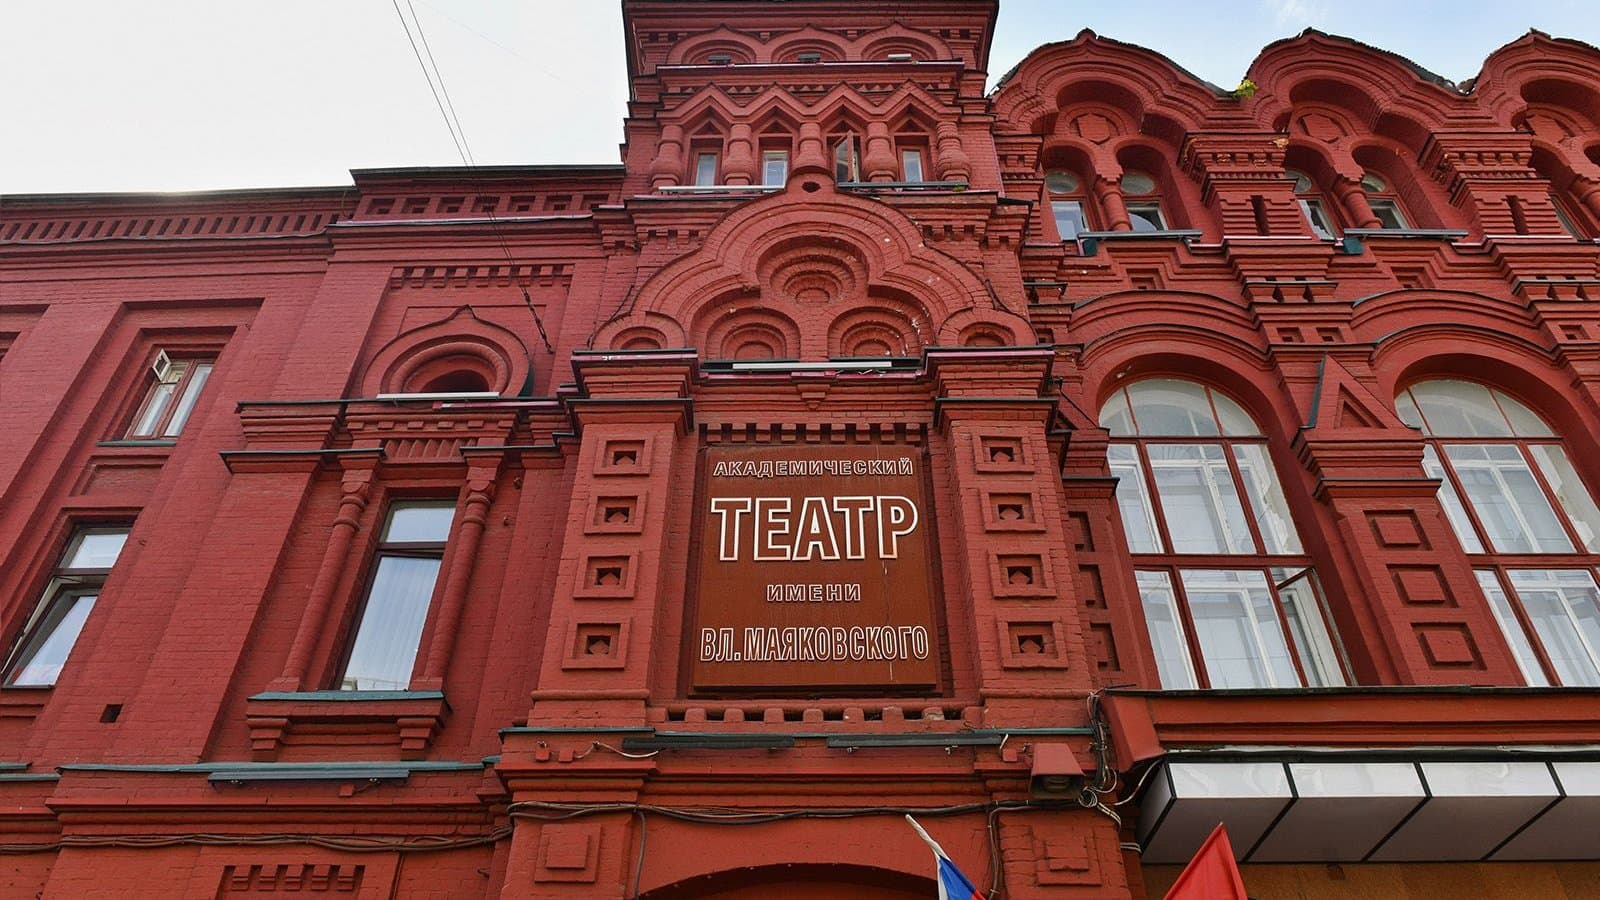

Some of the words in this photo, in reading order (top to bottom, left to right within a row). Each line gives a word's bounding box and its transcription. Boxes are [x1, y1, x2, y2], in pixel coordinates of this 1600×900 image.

[713, 457, 913, 477] АКАДЕМИЧЕСКИЙ
[711, 496, 918, 561] ТЕАТР
[767, 584, 861, 602] ИМЕНИ
